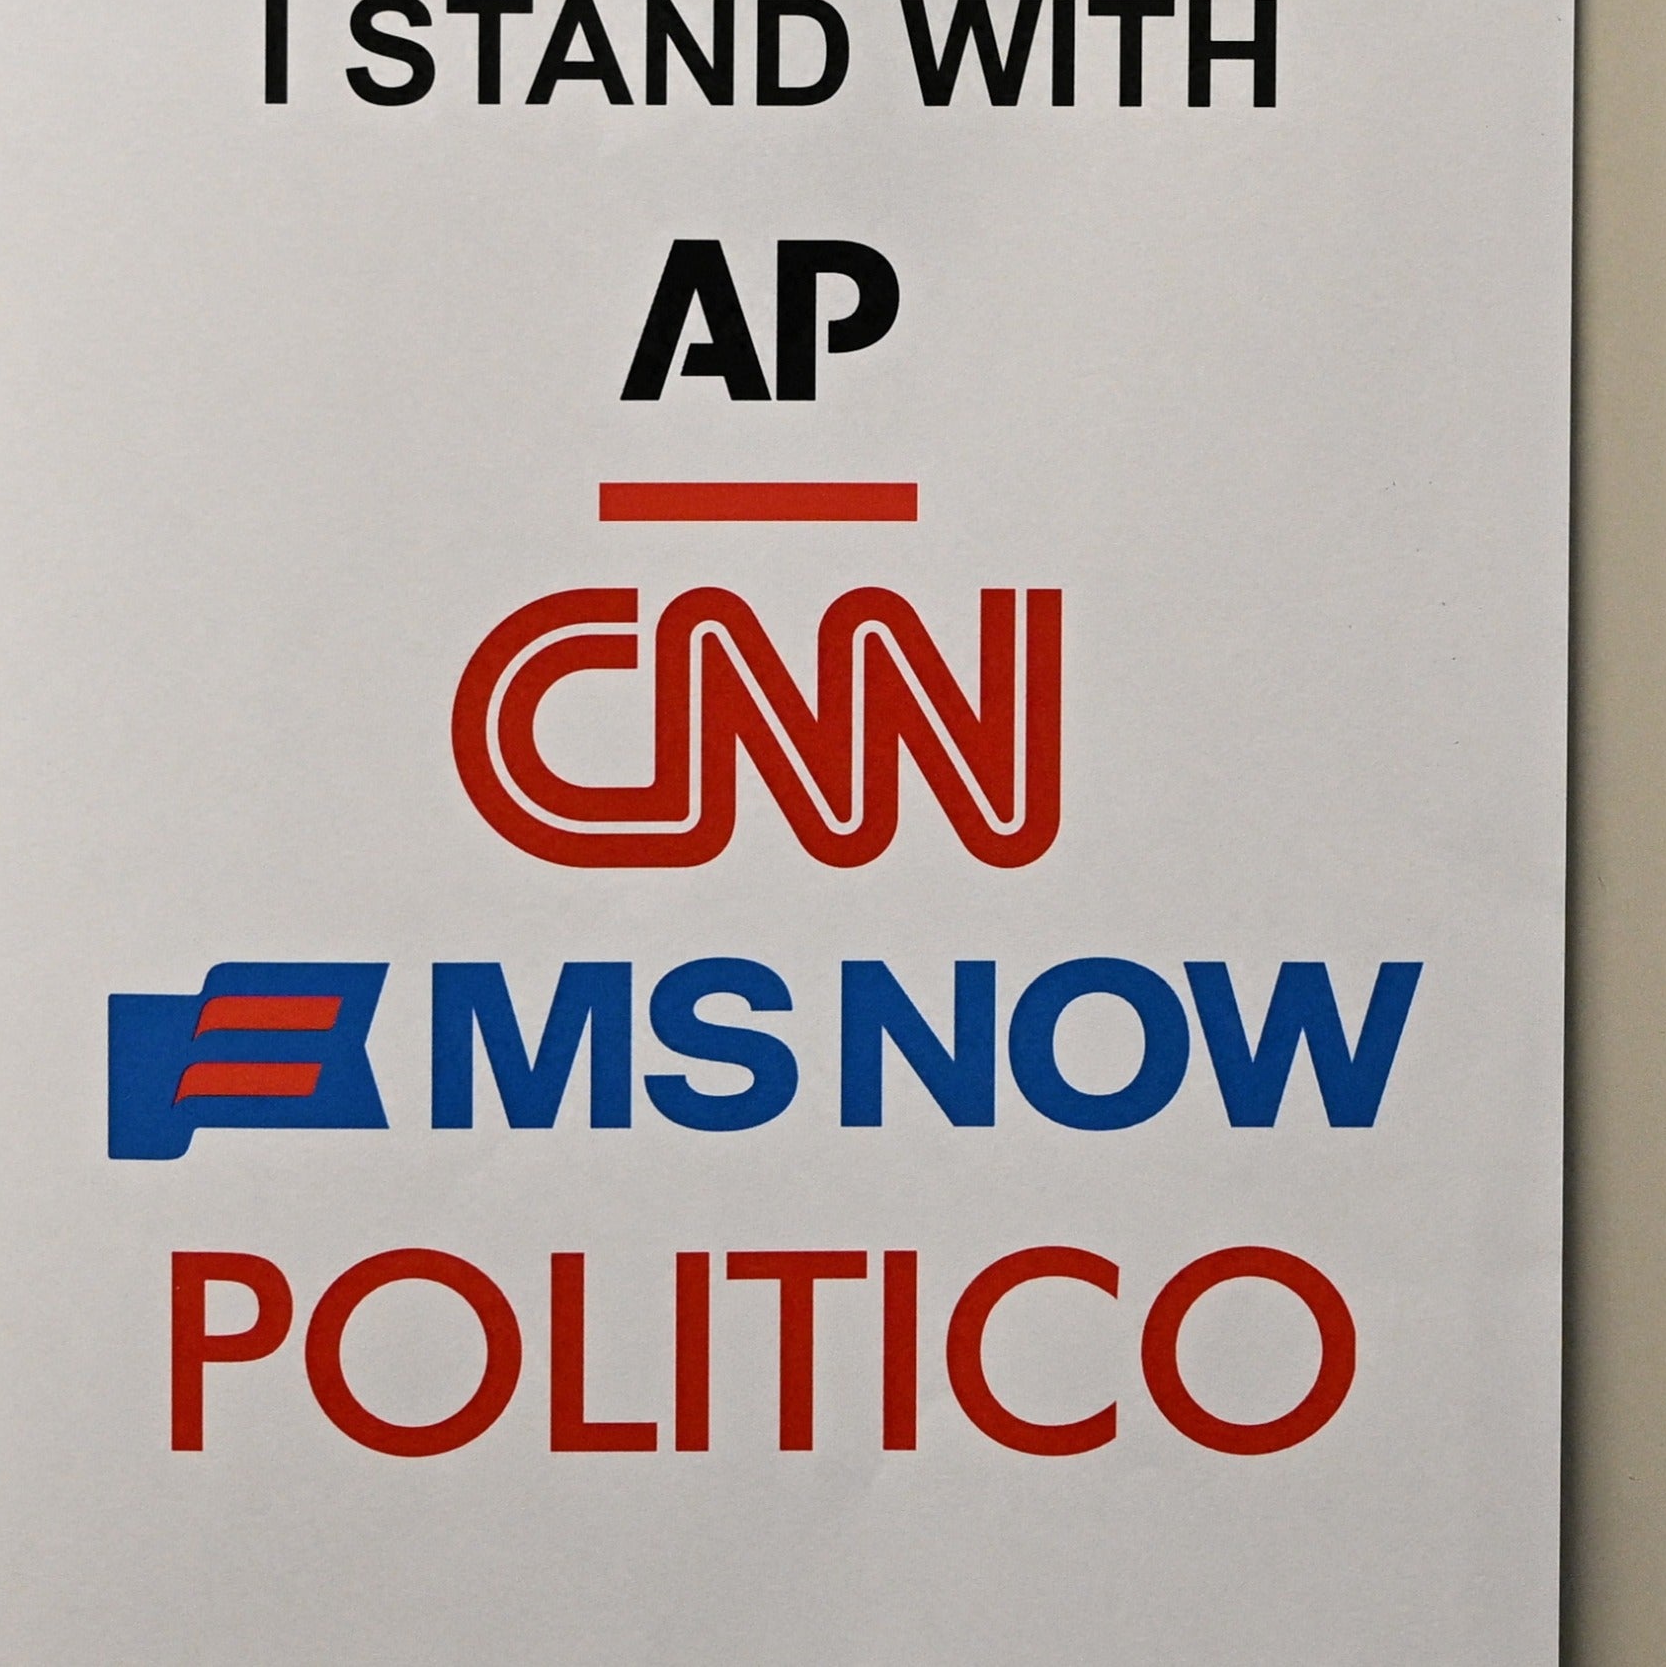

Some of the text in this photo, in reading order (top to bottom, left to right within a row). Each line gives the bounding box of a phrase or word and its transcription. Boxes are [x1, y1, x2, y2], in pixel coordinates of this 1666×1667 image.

[620, 239, 899, 401] AP
[452, 587, 1062, 868] CNN
[432, 957, 1423, 1131] MS NOW
[172, 1246, 1355, 1457] POLITICO
